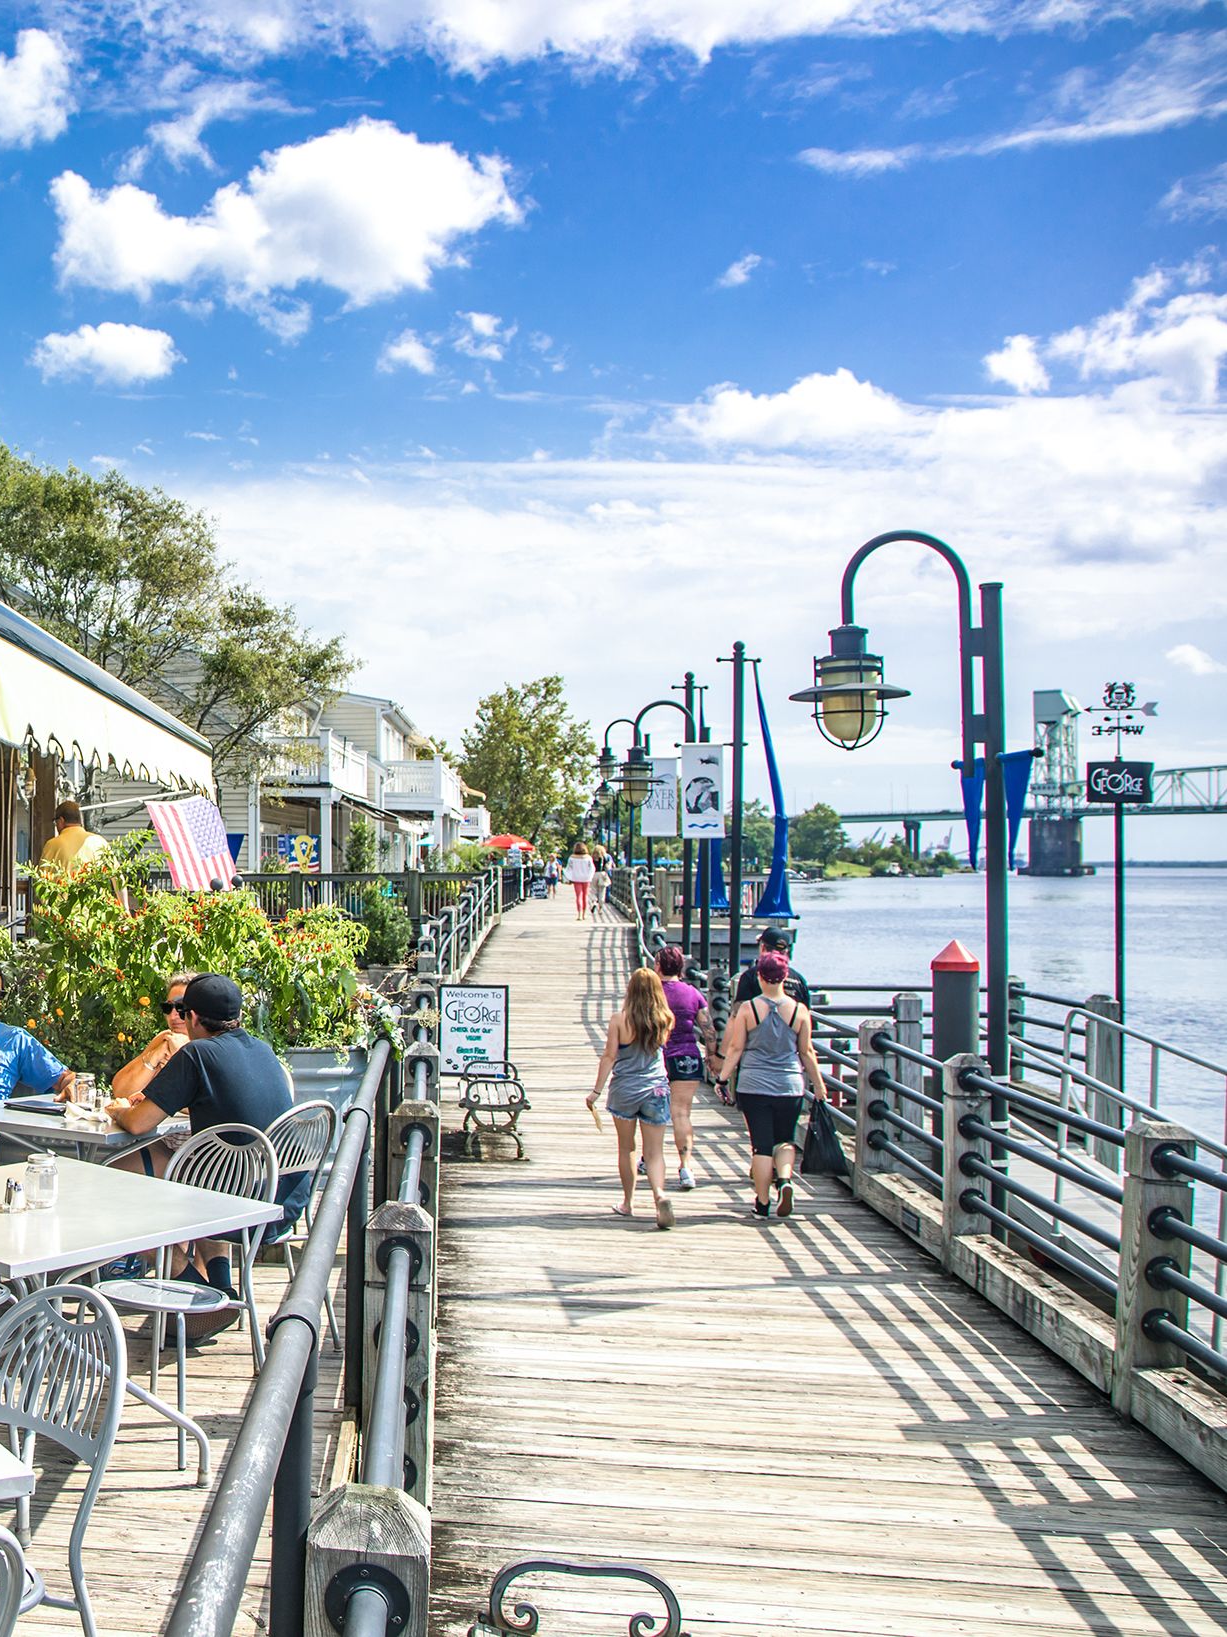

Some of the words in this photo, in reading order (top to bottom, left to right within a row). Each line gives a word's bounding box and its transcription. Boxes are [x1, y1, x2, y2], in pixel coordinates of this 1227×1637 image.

[1091, 768, 1144, 795] GEORGE
[645, 799, 675, 810] WALK
[446, 990, 489, 998] Welcome
[491, 991, 502, 999] To
[445, 1000, 501, 1024] GEORGE
